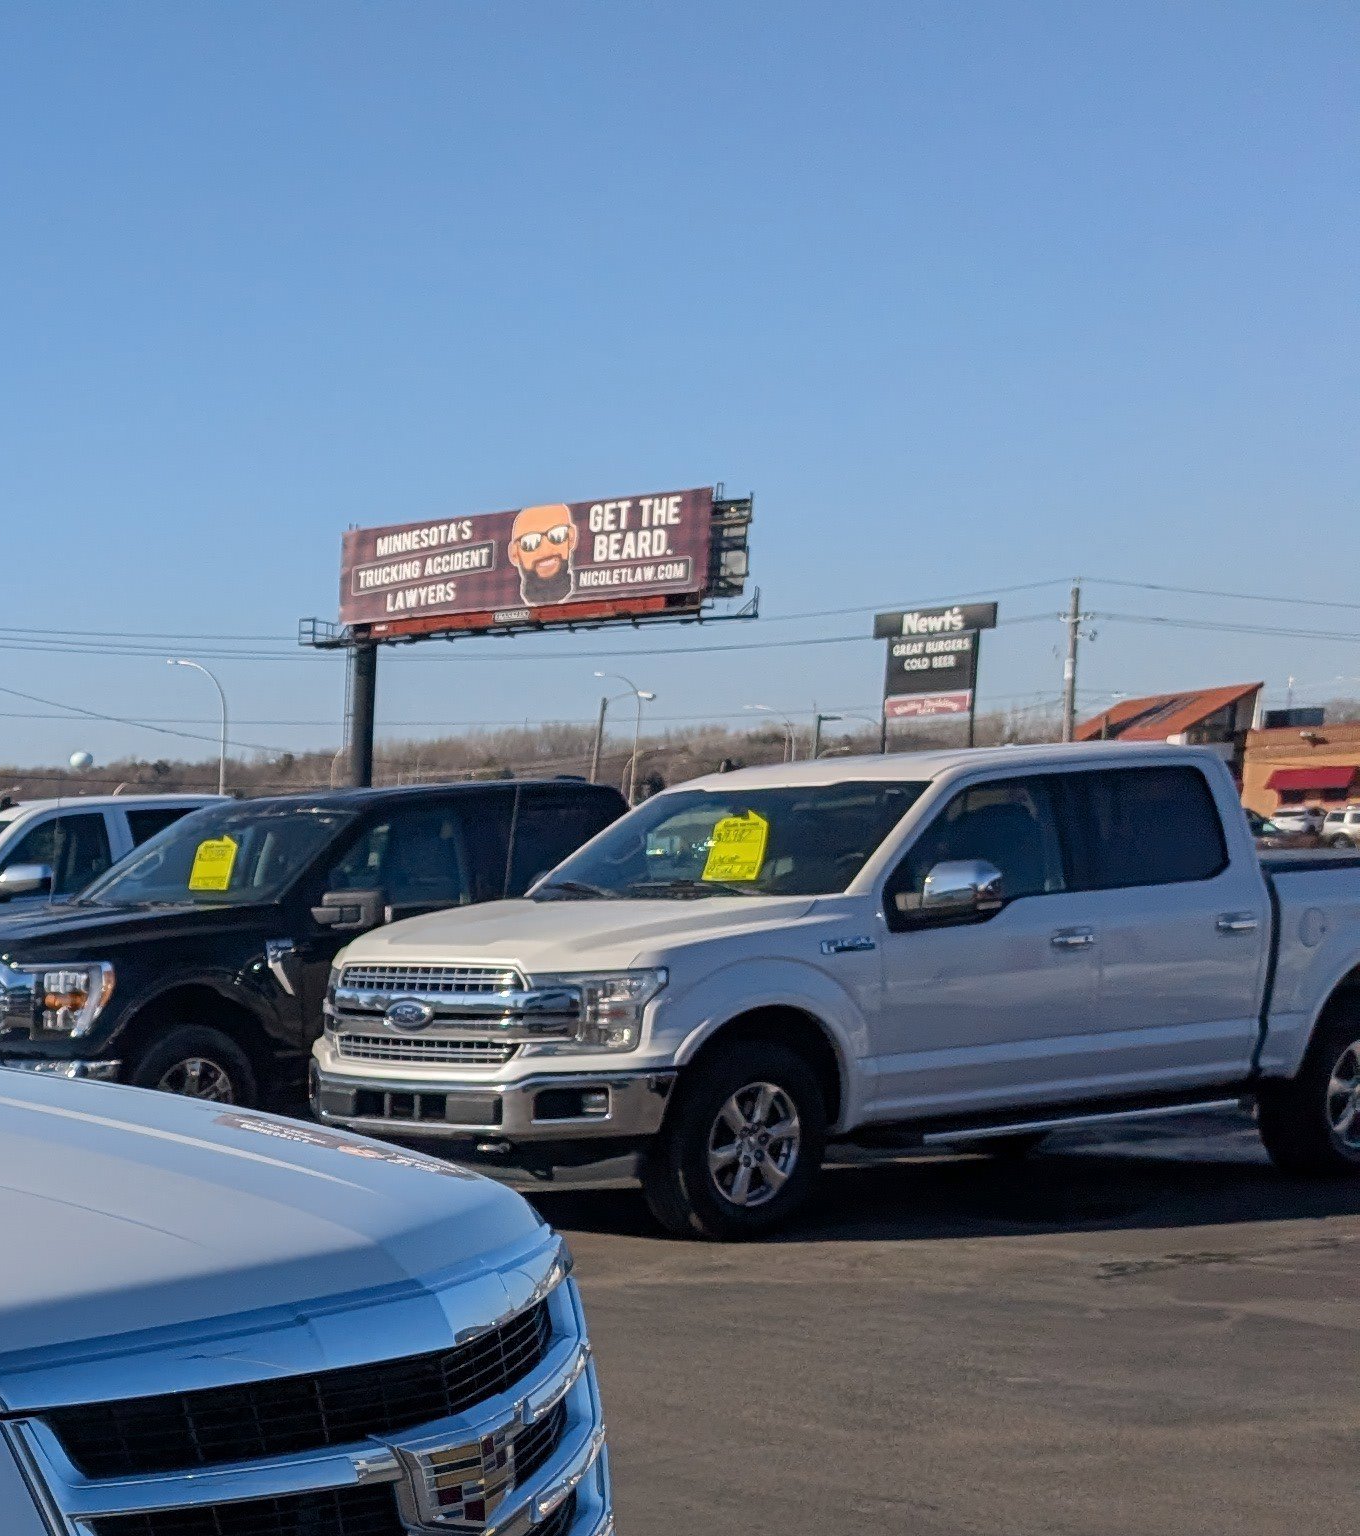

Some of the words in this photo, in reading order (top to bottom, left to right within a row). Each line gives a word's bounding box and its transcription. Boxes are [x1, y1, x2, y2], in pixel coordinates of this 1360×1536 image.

[589, 501, 632, 532] GET
[639, 496, 683, 527] THE
[376, 520, 473, 557] MINNESOTA'S
[593, 529, 674, 562] BEARD.
[359, 560, 421, 588] TRUCKING
[424, 548, 490, 576] ACCIDENT
[579, 563, 685, 587] NICOLETLAW.COM
[386, 582, 456, 612] LAWYERS
